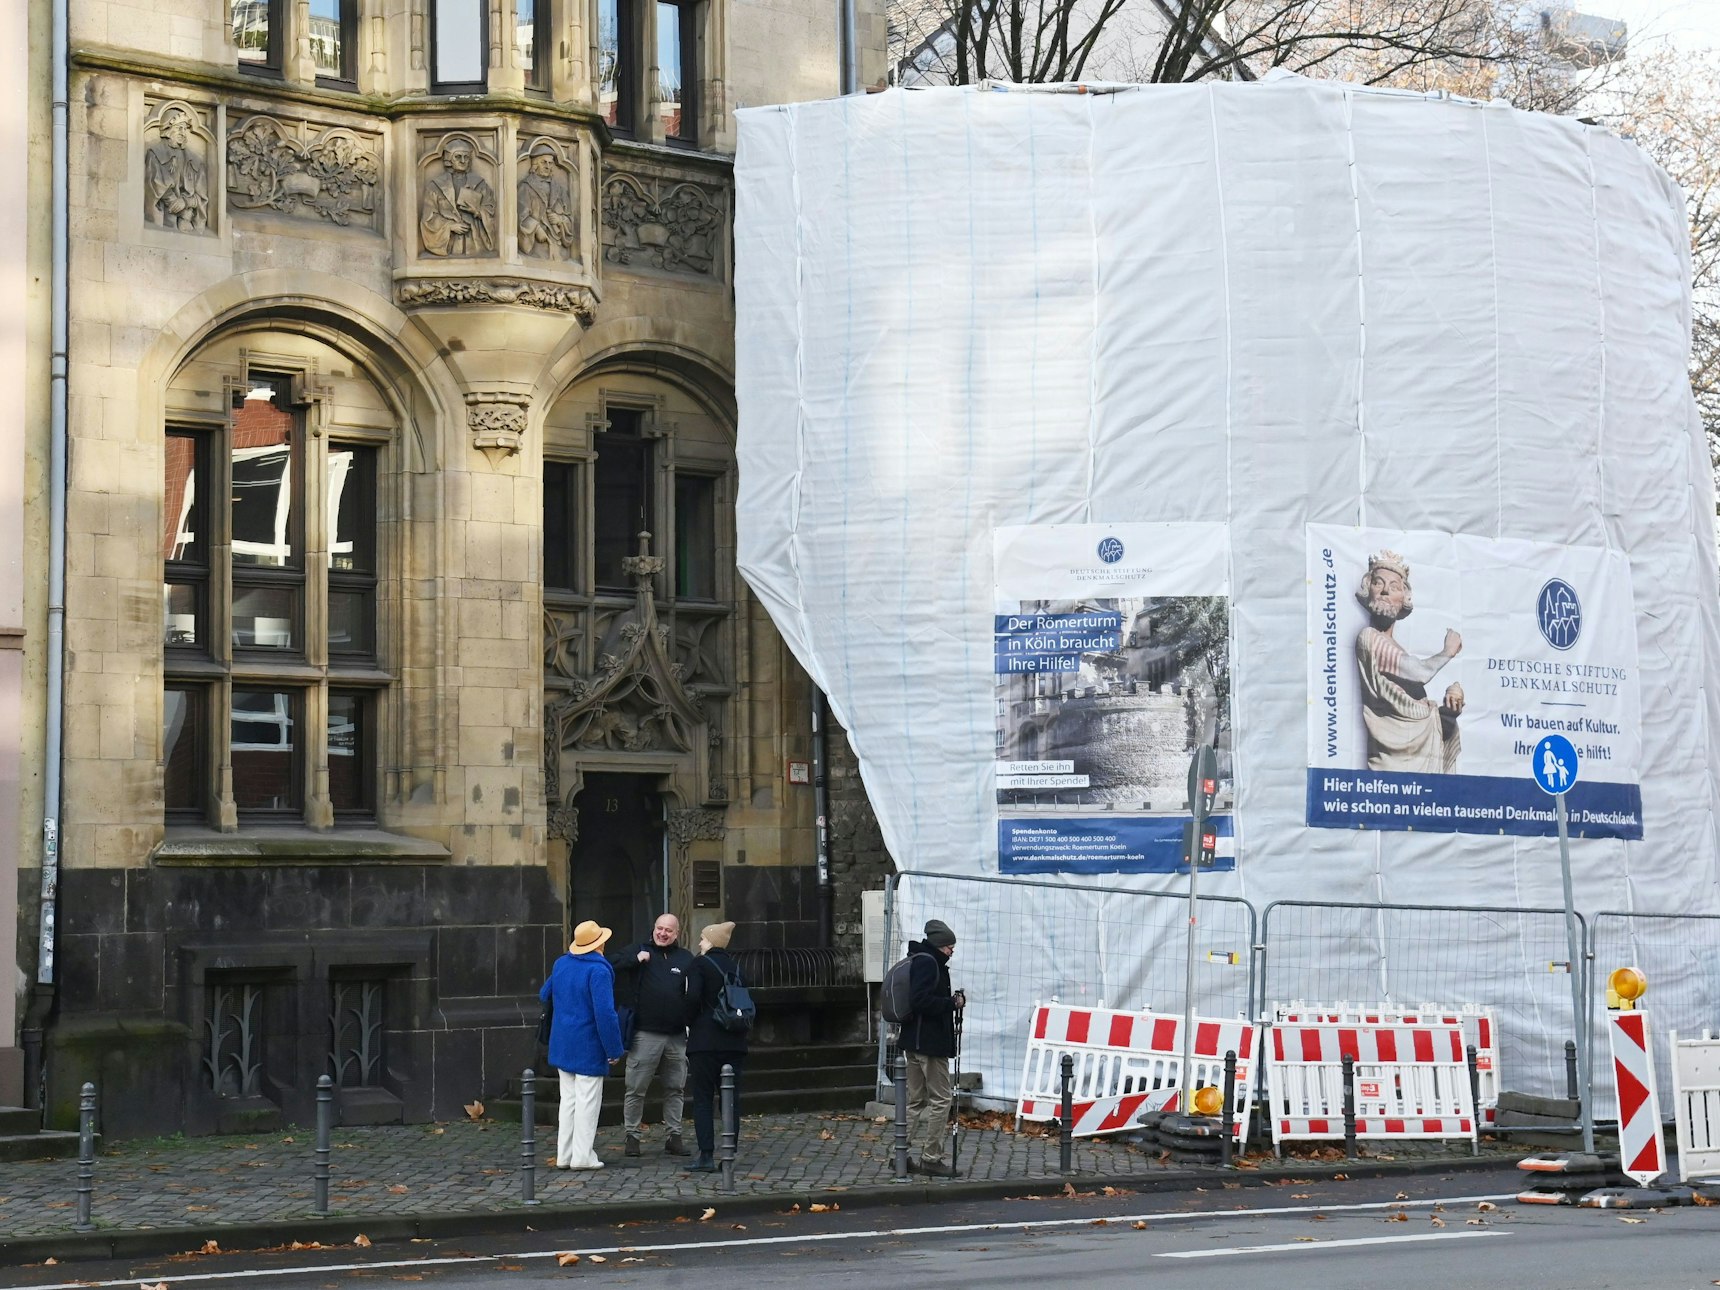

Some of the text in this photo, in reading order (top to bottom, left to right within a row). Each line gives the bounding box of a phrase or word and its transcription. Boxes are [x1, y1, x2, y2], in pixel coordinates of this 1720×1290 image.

[1008, 616, 1117, 630] Der Römerturm
[1008, 635, 1115, 651] in Köln braucht
[1322, 548, 1337, 758] www.denkmalschutz.de
[1008, 656, 1075, 671] Ihre Hilfe!
[1487, 658, 1627, 681] DEUTSCHE STIFTUNG
[1500, 676, 1618, 696] DENKMALSCHUTZ
[1501, 713, 1621, 735] Wir bauen auf Kultur.
[1586, 744, 1612, 760] hilft!
[1010, 761, 1071, 771] Retten Sie ihn
[1010, 776, 1087, 787] mit Ihrer Spende!
[1323, 777, 1354, 792] Hier
[1356, 778, 1399, 795] helfen
[1401, 781, 1422, 796] wir
[1323, 798, 1349, 812] wie
[1351, 799, 1391, 814] schon
[1393, 804, 1410, 815] an
[1412, 802, 1451, 817] vielen
[1454, 804, 1503, 819] tausend
[1570, 809, 1581, 822] in
[1582, 809, 1638, 825] Deutschland.
